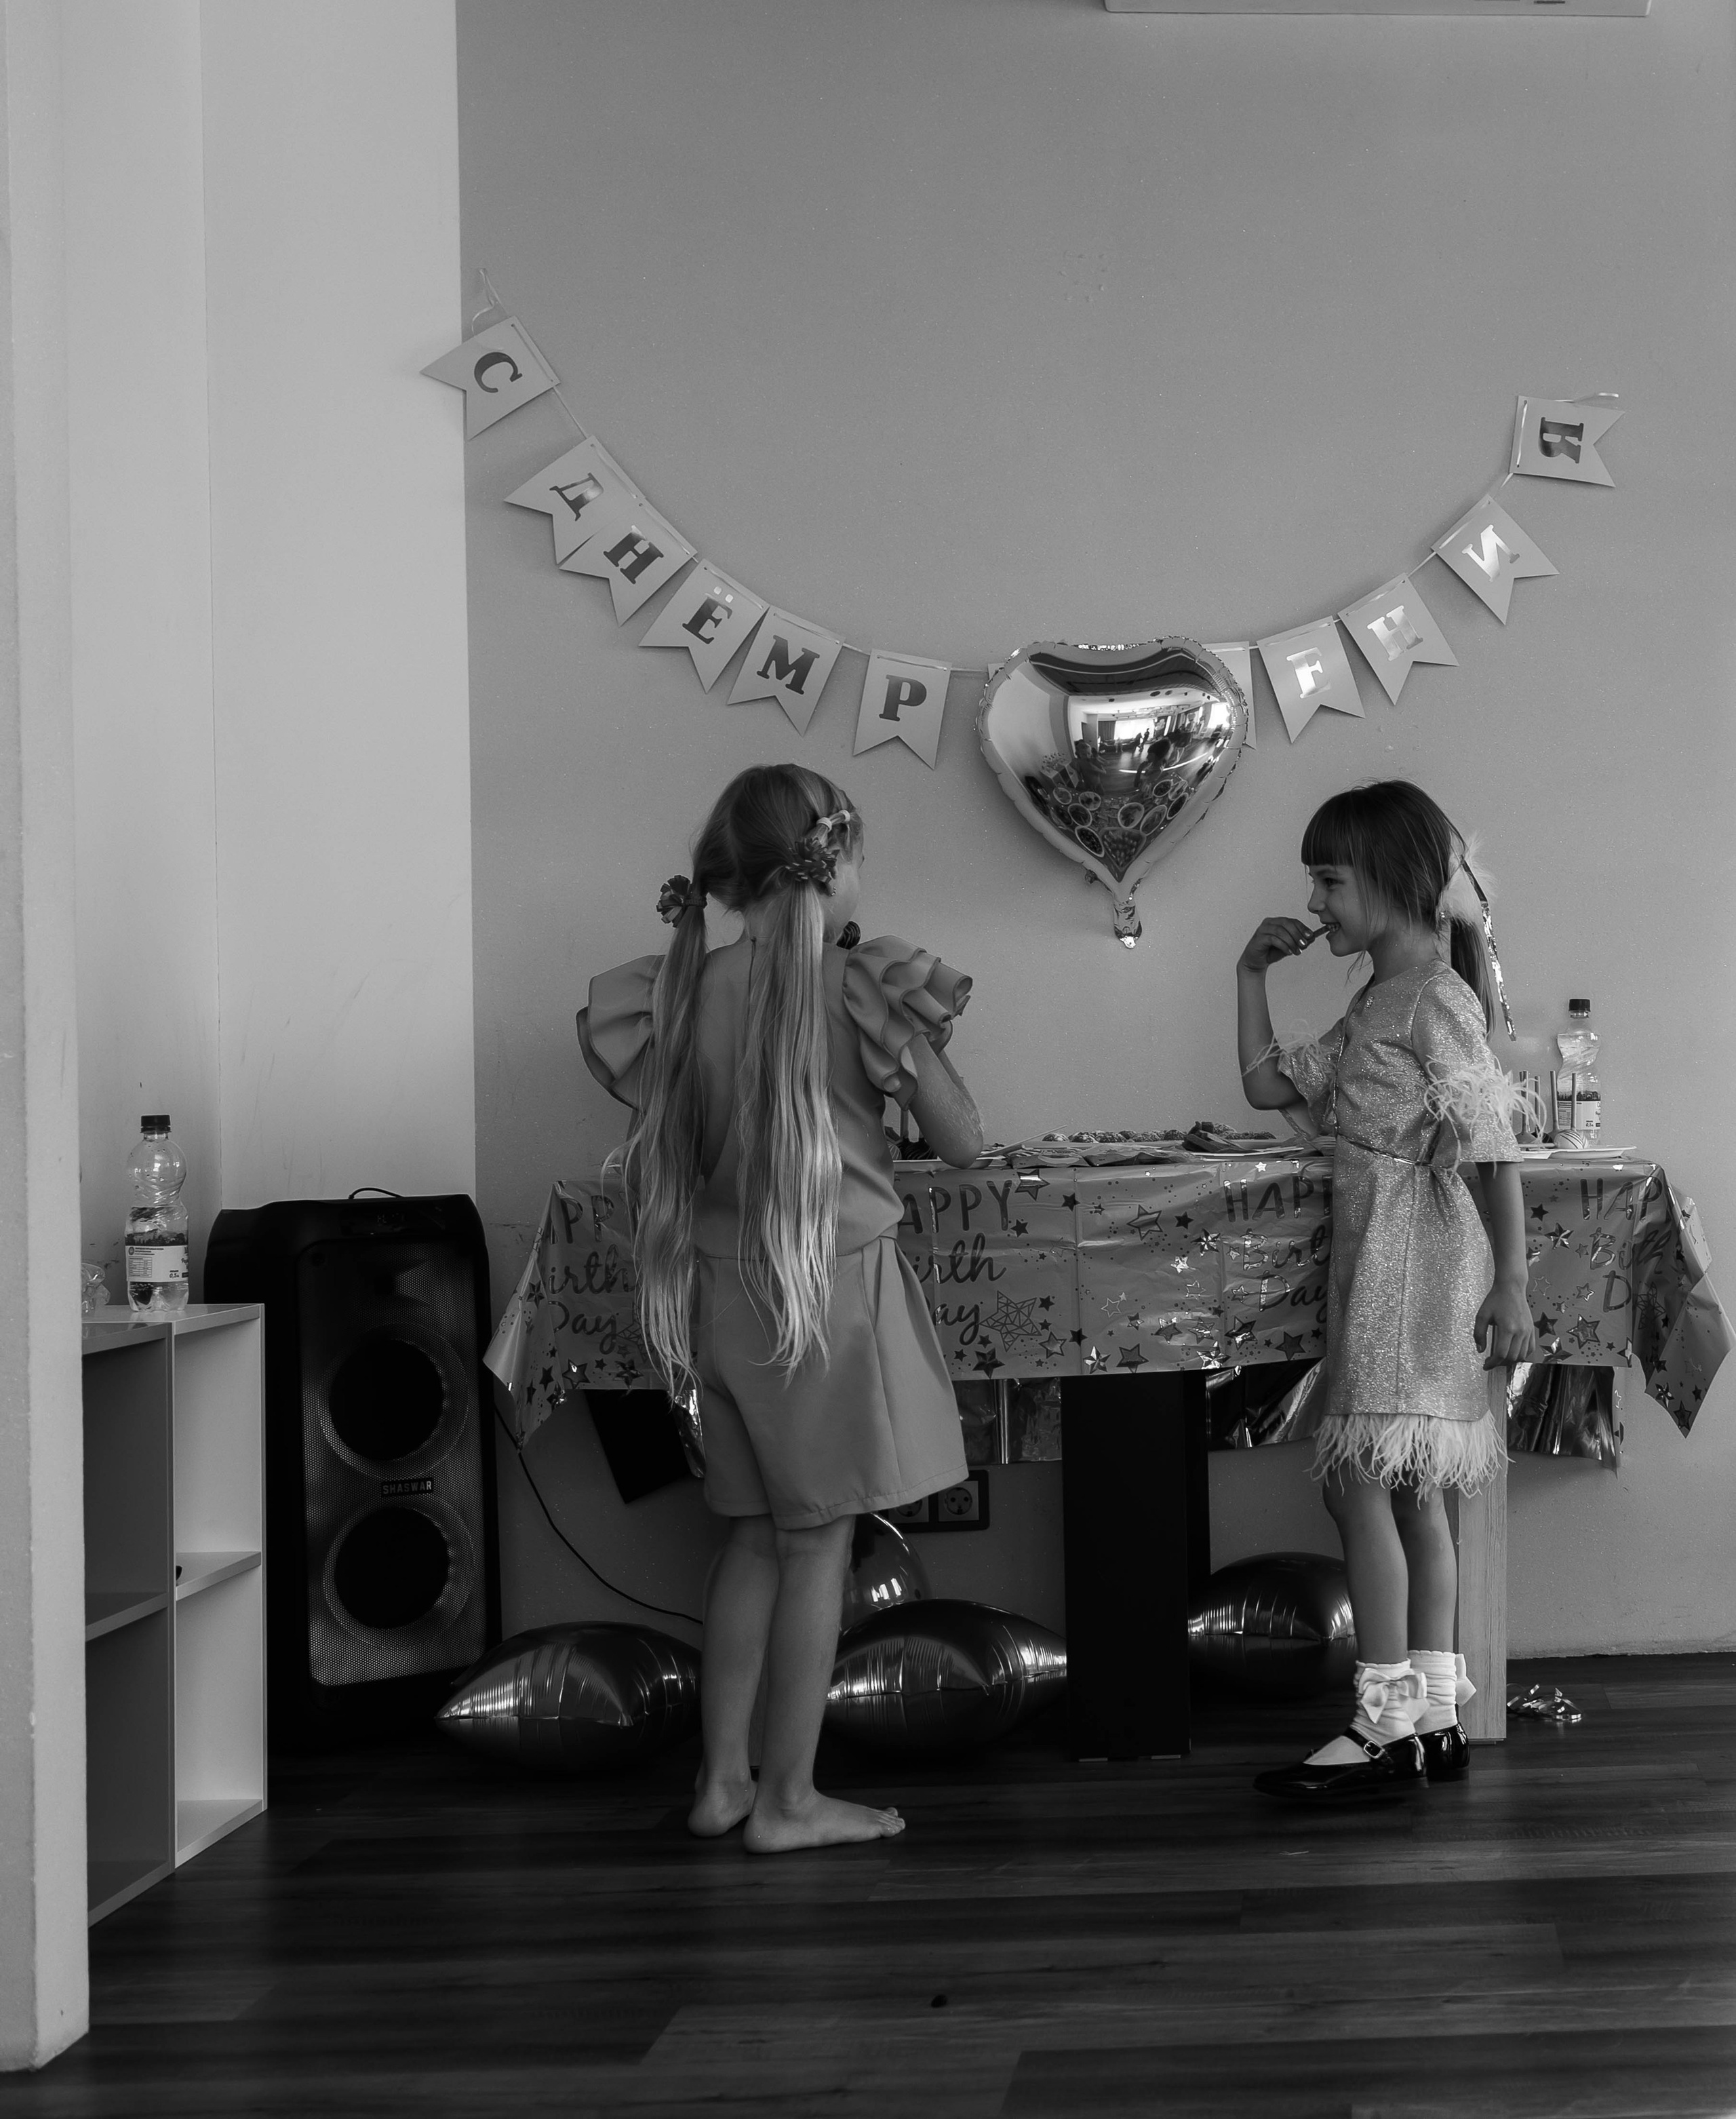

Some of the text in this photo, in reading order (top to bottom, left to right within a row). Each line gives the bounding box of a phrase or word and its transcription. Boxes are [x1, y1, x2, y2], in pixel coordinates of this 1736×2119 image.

[473, 351, 523, 393] С
[549, 472, 820, 695] ДНЁМ
[898, 1180, 1012, 1234] APPY
[1223, 1174, 1333, 1222] HAP
[1580, 1175, 1664, 1222] HAP
[549, 1243, 635, 1294] irth
[904, 1232, 1007, 1283] irth
[1240, 1224, 1330, 1270] Birt
[926, 1296, 980, 1346] ay
